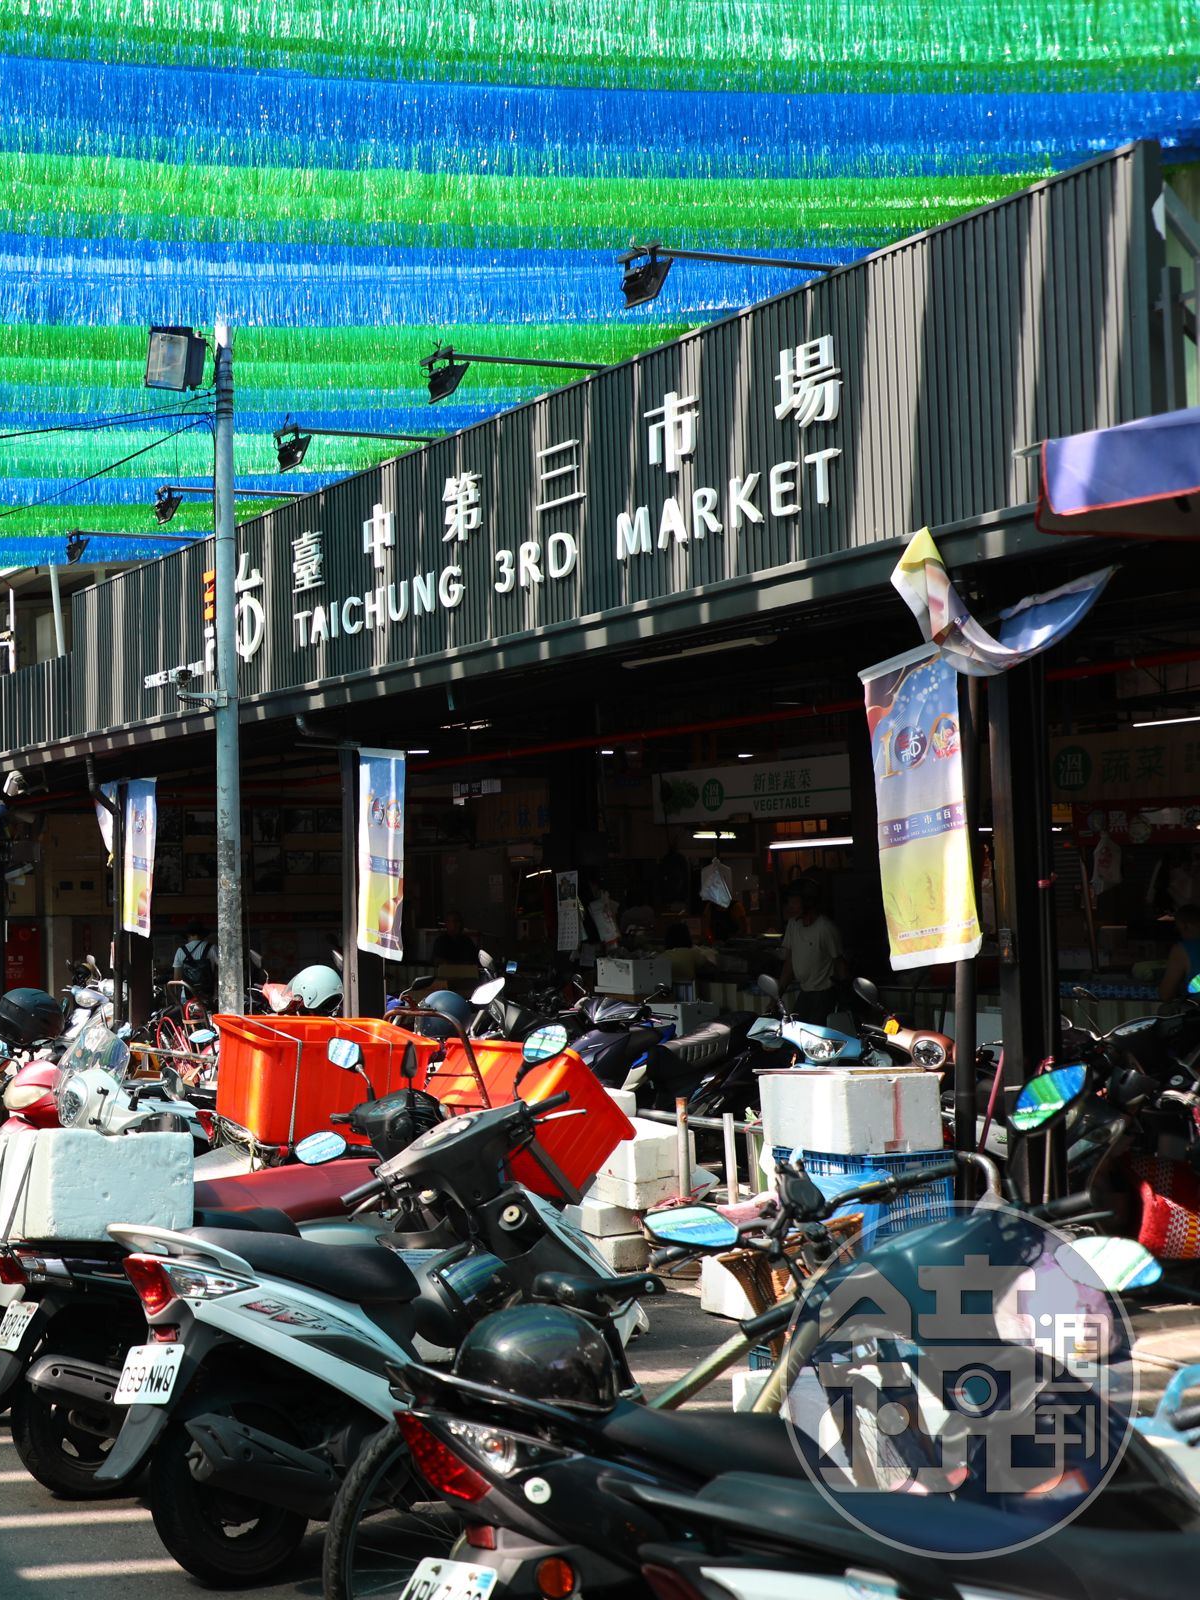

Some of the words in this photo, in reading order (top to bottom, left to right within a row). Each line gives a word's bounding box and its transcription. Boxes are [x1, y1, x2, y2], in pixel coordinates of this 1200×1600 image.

[291, 334, 842, 593] 臺中第三市場
[293, 565, 465, 647] TAICHUNG
[494, 531, 579, 593] 3RD
[616, 447, 842, 560] MARKET
[753, 769, 812, 793] 新鮮蔬菜
[753, 796, 811, 811] VEGETABLE
